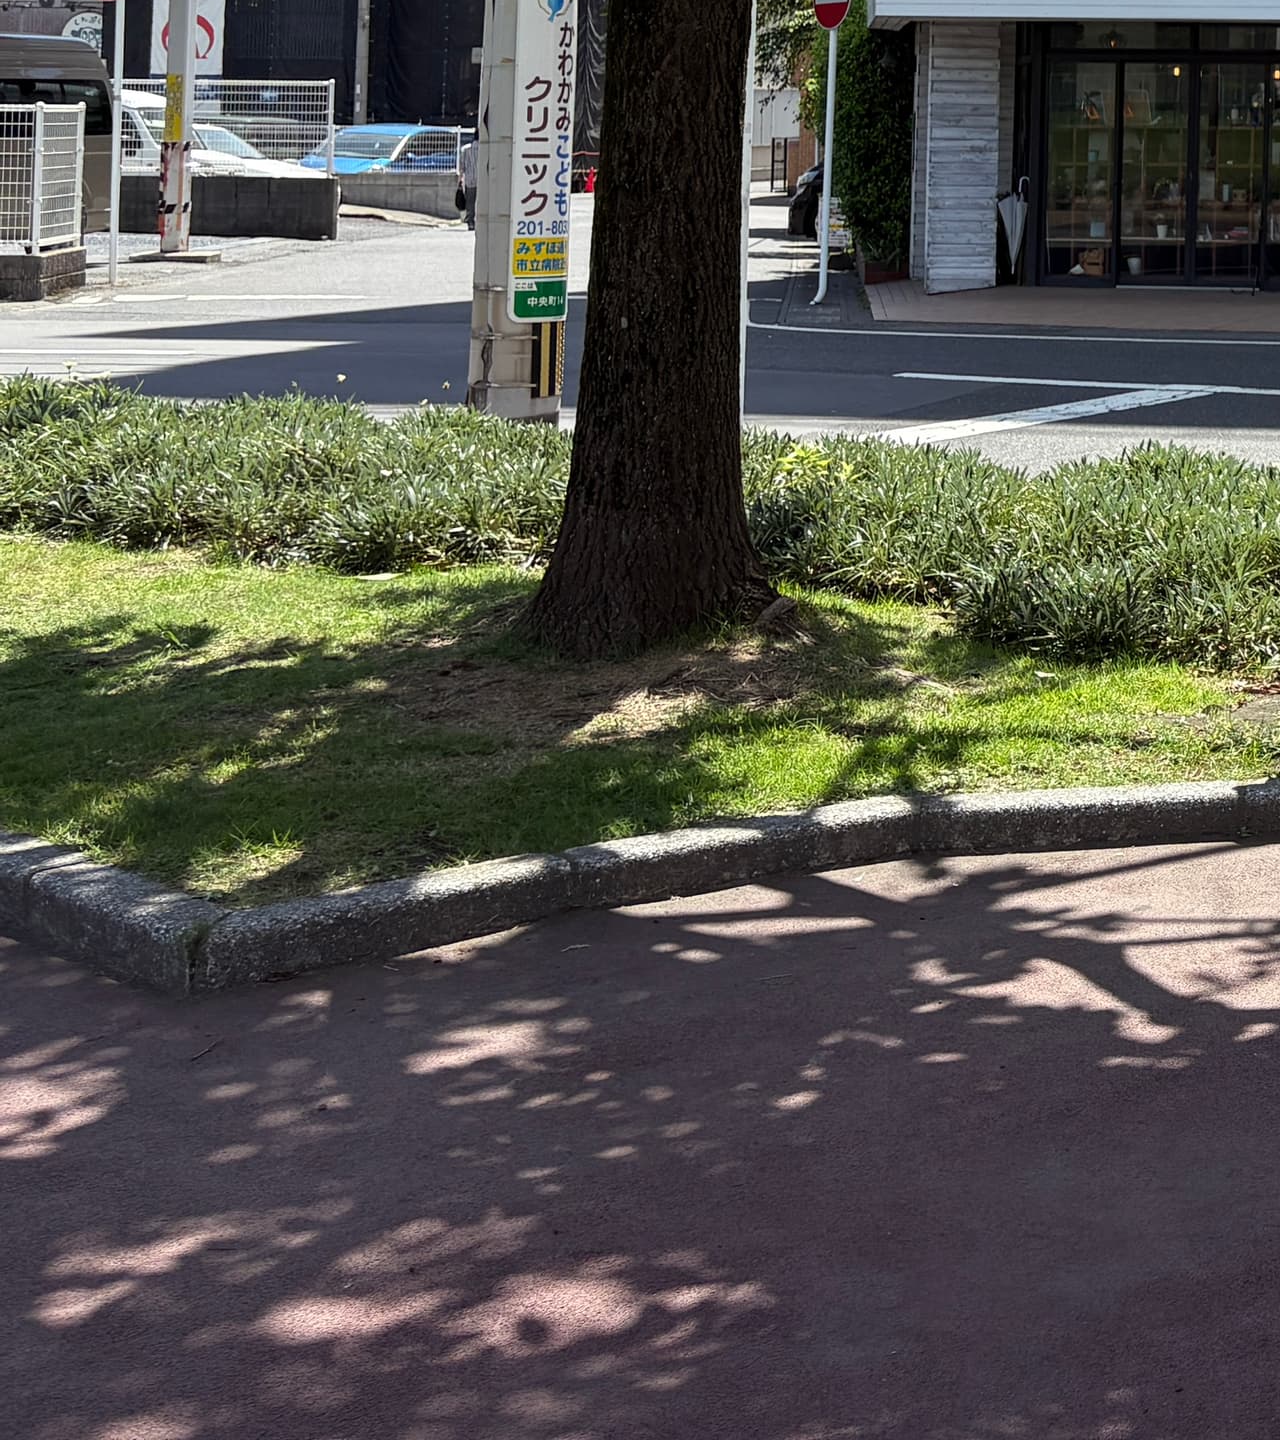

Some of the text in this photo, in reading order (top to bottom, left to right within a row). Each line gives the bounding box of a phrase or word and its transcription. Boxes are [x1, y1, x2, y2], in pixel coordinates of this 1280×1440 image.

[521, 76, 552, 217] クリニック
[554, 21, 575, 218] かわかみこども
